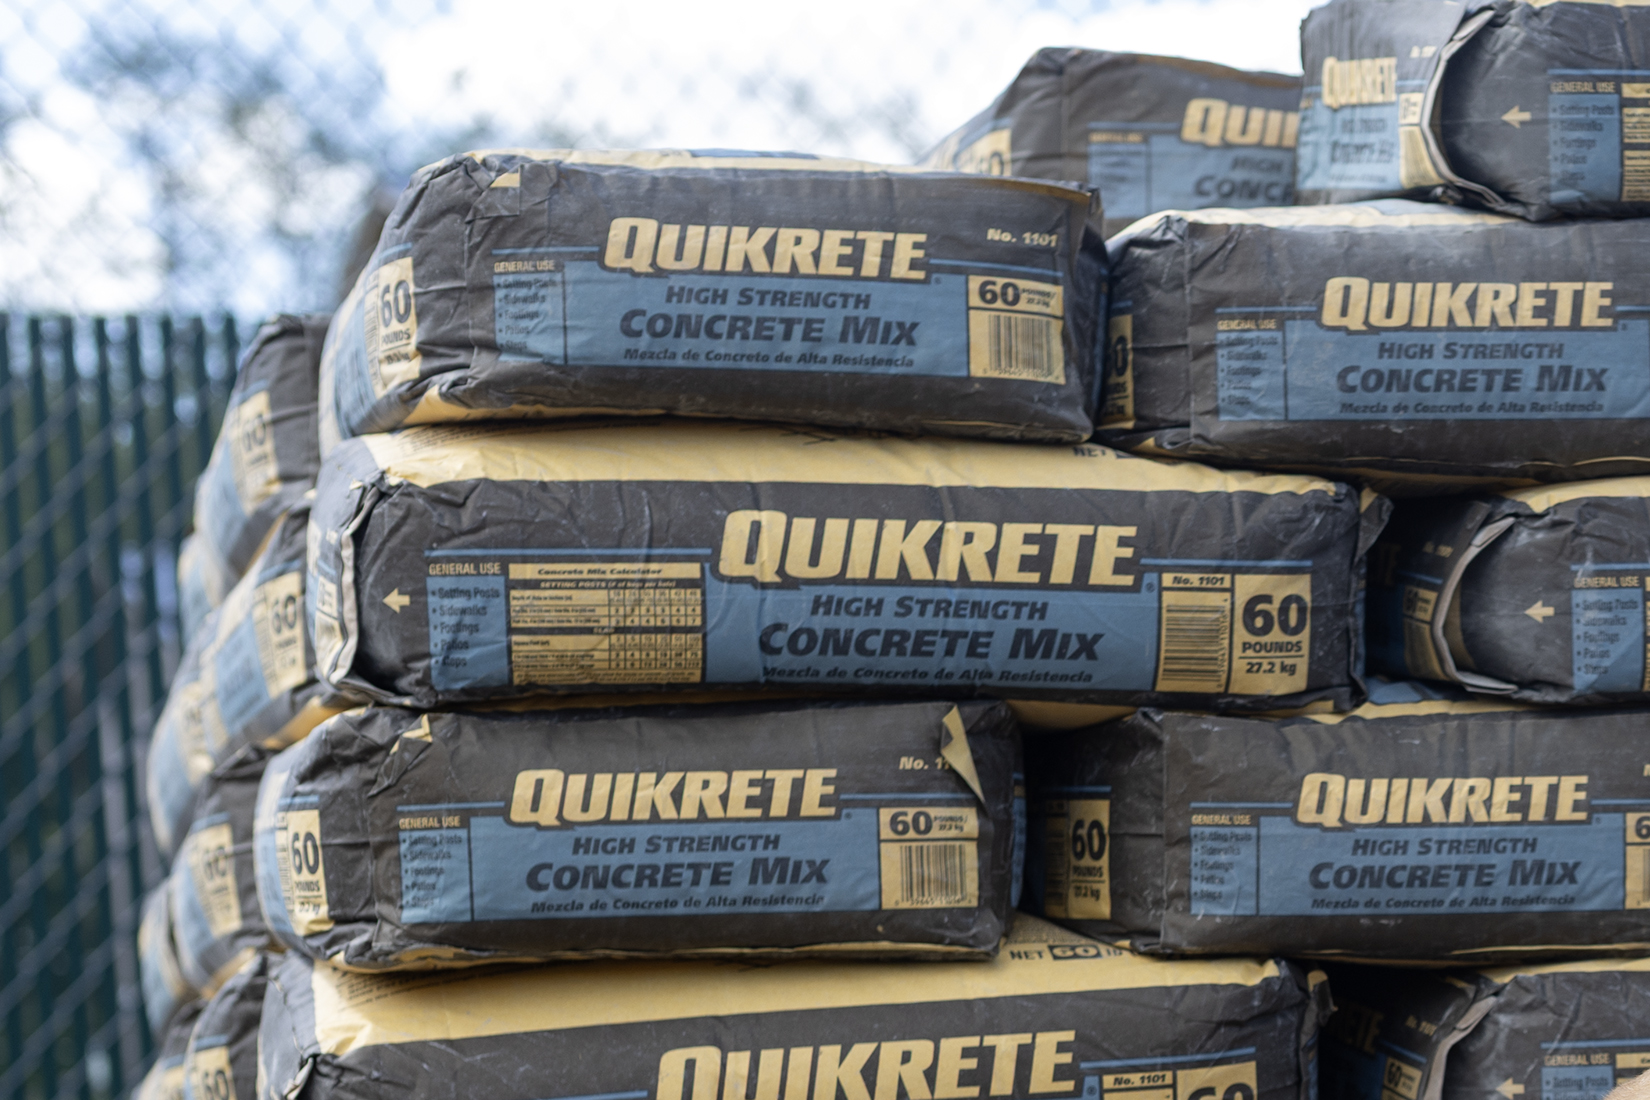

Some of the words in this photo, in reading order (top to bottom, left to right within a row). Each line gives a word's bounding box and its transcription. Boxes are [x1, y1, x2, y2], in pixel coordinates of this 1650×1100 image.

[1551, 82, 1594, 94] GENERAL
[1597, 81, 1616, 93] USE
[1231, 155, 1284, 173] HIGH
[604, 217, 928, 279] QUIKRETE
[986, 227, 1017, 243] No.
[1021, 231, 1058, 248] 1101
[380, 279, 412, 328] 60
[664, 285, 728, 306] HIGH
[737, 286, 872, 310] STRENGTH
[978, 280, 1021, 306] 60
[1321, 276, 1613, 331] QUIKRETE
[619, 308, 826, 343] CONCRETE
[838, 315, 921, 347] MIX
[1377, 342, 1435, 360] HIGH
[1442, 342, 1564, 360] STRENGTH
[1336, 365, 1523, 393] CONCRETE
[1535, 365, 1608, 392] MIX
[718, 509, 1138, 587] QUIKRETE
[429, 563, 477, 575] GENERAL
[480, 562, 501, 574] USE
[1172, 576, 1194, 586] No.
[1198, 576, 1225, 586] 1101
[438, 587, 470, 600] Setting
[475, 586, 500, 599] Posts
[810, 594, 884, 617] HIGH
[894, 595, 1049, 622] STRENGTH
[1241, 593, 1308, 638] 60
[759, 622, 995, 660] CONCRETE
[1008, 627, 1105, 662] MIX
[1241, 640, 1303, 654] POUNDS
[763, 666, 820, 679] Mezcla
[826, 666, 847, 679] de
[853, 667, 928, 680] Concreto
[934, 667, 955, 681] de
[959, 668, 993, 682] Alta
[1245, 661, 1276, 674] 27.2
[1279, 661, 1297, 676] kg
[899, 756, 929, 770] No.
[509, 768, 838, 826] QUIKRETE
[1296, 773, 1589, 827] QUIKRETE
[399, 818, 439, 829] GENERAL
[442, 816, 461, 827] USE
[889, 810, 934, 836] 60
[571, 836, 636, 856] HIGH
[644, 834, 781, 854] STRENGTH
[1071, 818, 1107, 862] 60
[1351, 838, 1410, 857] HIGH
[1417, 837, 1538, 856] STRENGTH
[291, 831, 319, 875] 60
[525, 861, 734, 893] CONCRETE
[749, 856, 831, 886] MIX
[1308, 861, 1496, 890] CONCRETE
[1508, 859, 1583, 887] MIX
[1010, 950, 1044, 960] NET
[1544, 1054, 1585, 1066] GENERAL
[1588, 1053, 1609, 1064] USE
[1113, 1076, 1135, 1086] No.
[1139, 1073, 1166, 1085] 1101
